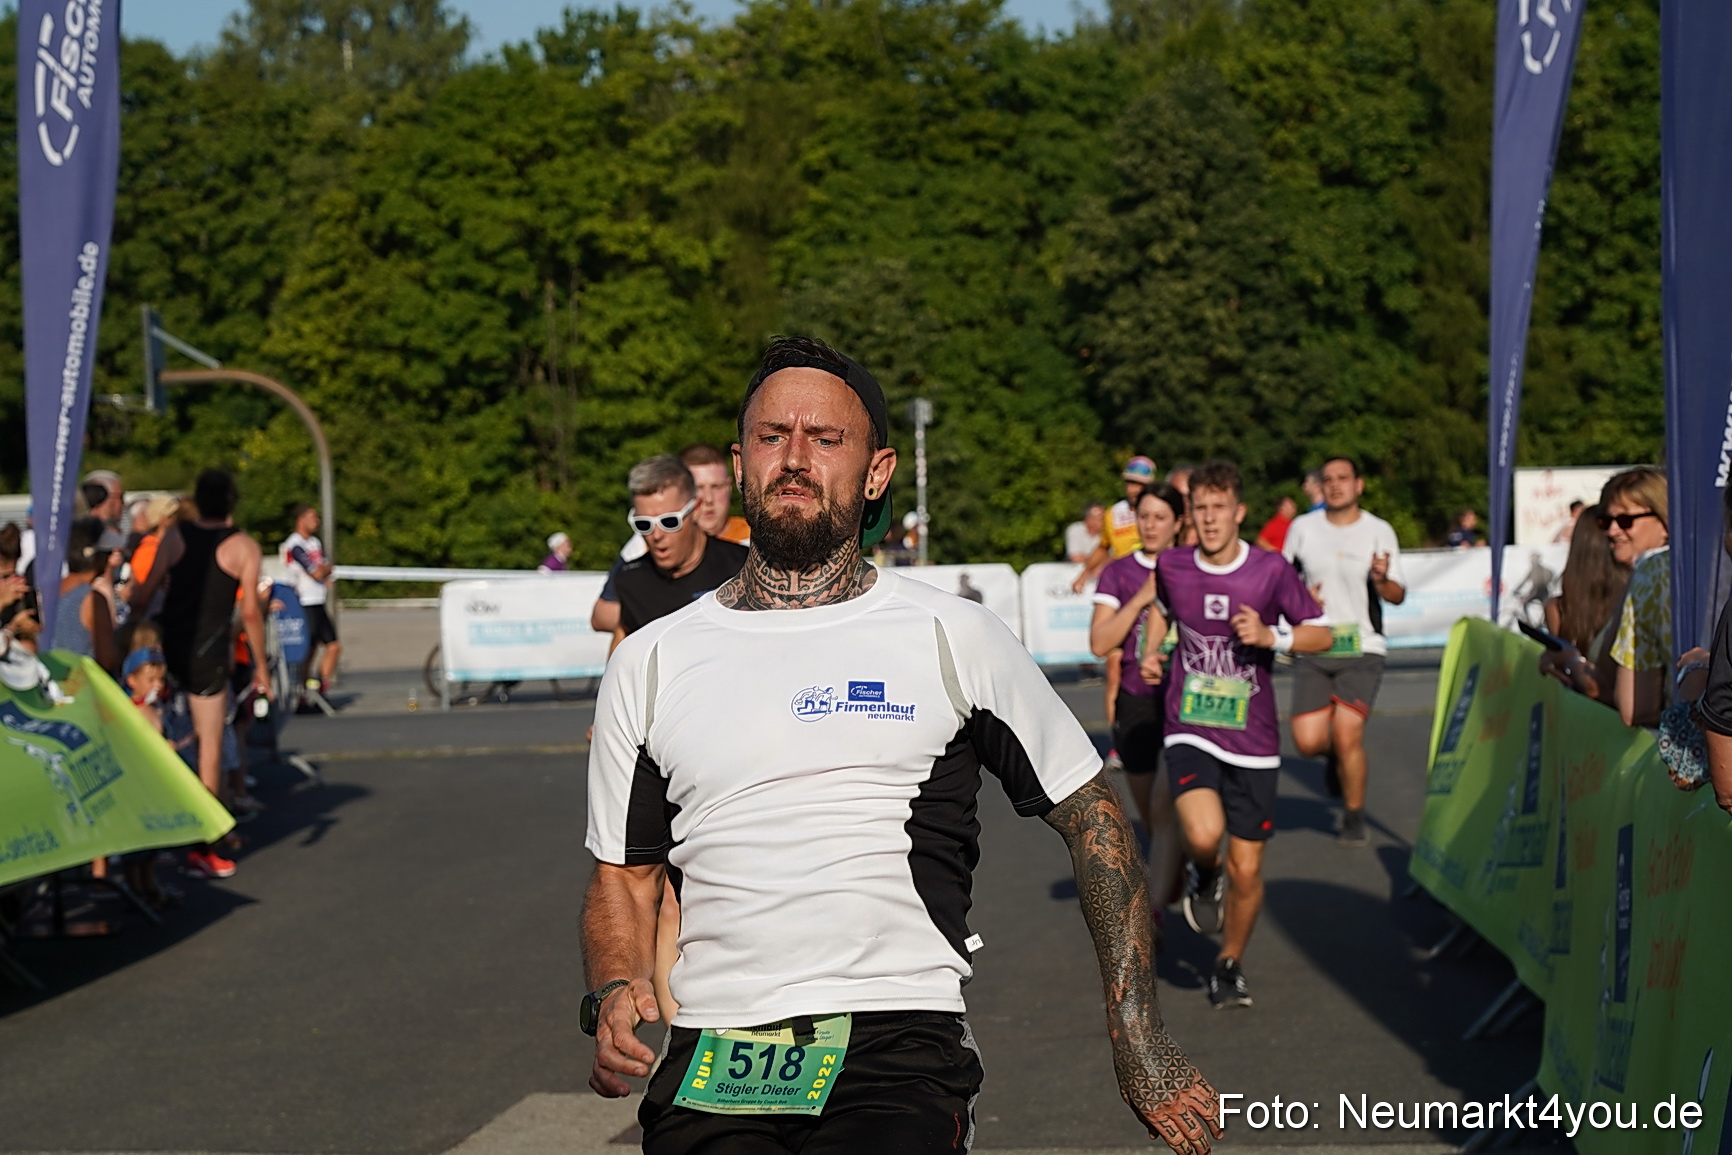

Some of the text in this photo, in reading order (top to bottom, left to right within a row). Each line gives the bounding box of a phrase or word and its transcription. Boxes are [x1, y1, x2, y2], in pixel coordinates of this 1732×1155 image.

[836, 702, 915, 714] Firmenlauf
[1195, 693, 1236, 711] 1571
[867, 713, 915, 722] neumarkt
[691, 1051, 715, 1090] RUN
[728, 1041, 806, 1082] 518
[807, 1054, 837, 1101] 2022
[714, 1082, 802, 1097] Stigler Dieter
